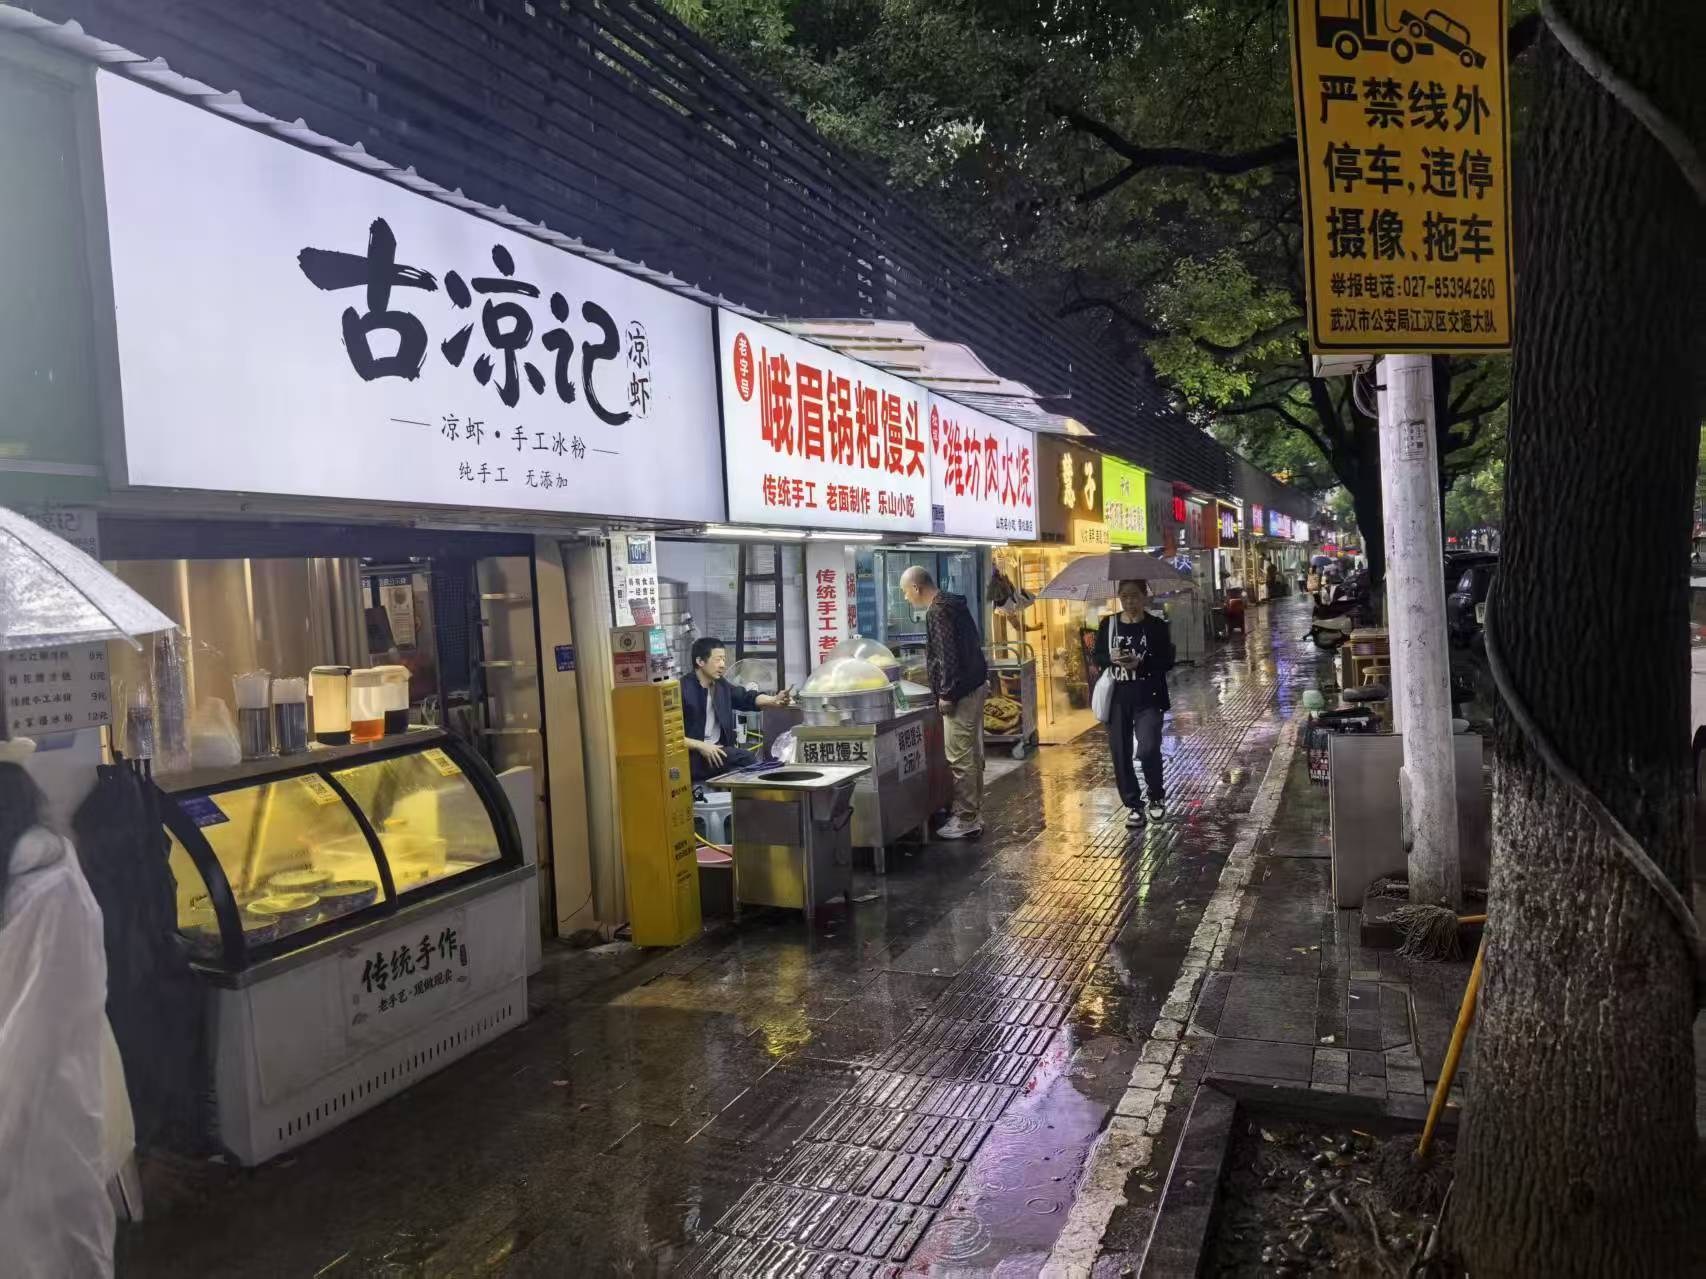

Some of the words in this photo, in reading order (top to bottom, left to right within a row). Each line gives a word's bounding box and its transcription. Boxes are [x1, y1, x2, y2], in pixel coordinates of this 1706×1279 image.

[1318, 74, 1490, 135] 严禁线外
[1323, 141, 1494, 200] 停车，违停
[1326, 206, 1495, 264] 摄像、拖车
[297, 216, 632, 426] 古凉记
[1330, 307, 1497, 333] 武汉市公安局江汉区交通大队
[627, 331, 650, 414] 凉虾
[758, 346, 925, 479] 峨眉锅粑馒头
[459, 462, 509, 484] 纯手工
[525, 469, 569, 489] 无添加
[943, 419, 1032, 510] 潍坊肉火烧
[762, 474, 817, 509] 传统手工
[826, 482, 871, 514] 老面制作
[878, 491, 915, 518] 乐山小吃
[1140, 634, 1147, 648] A
[803, 742, 867, 763] 锅粑馒头
[361, 927, 458, 993] 传统手作
